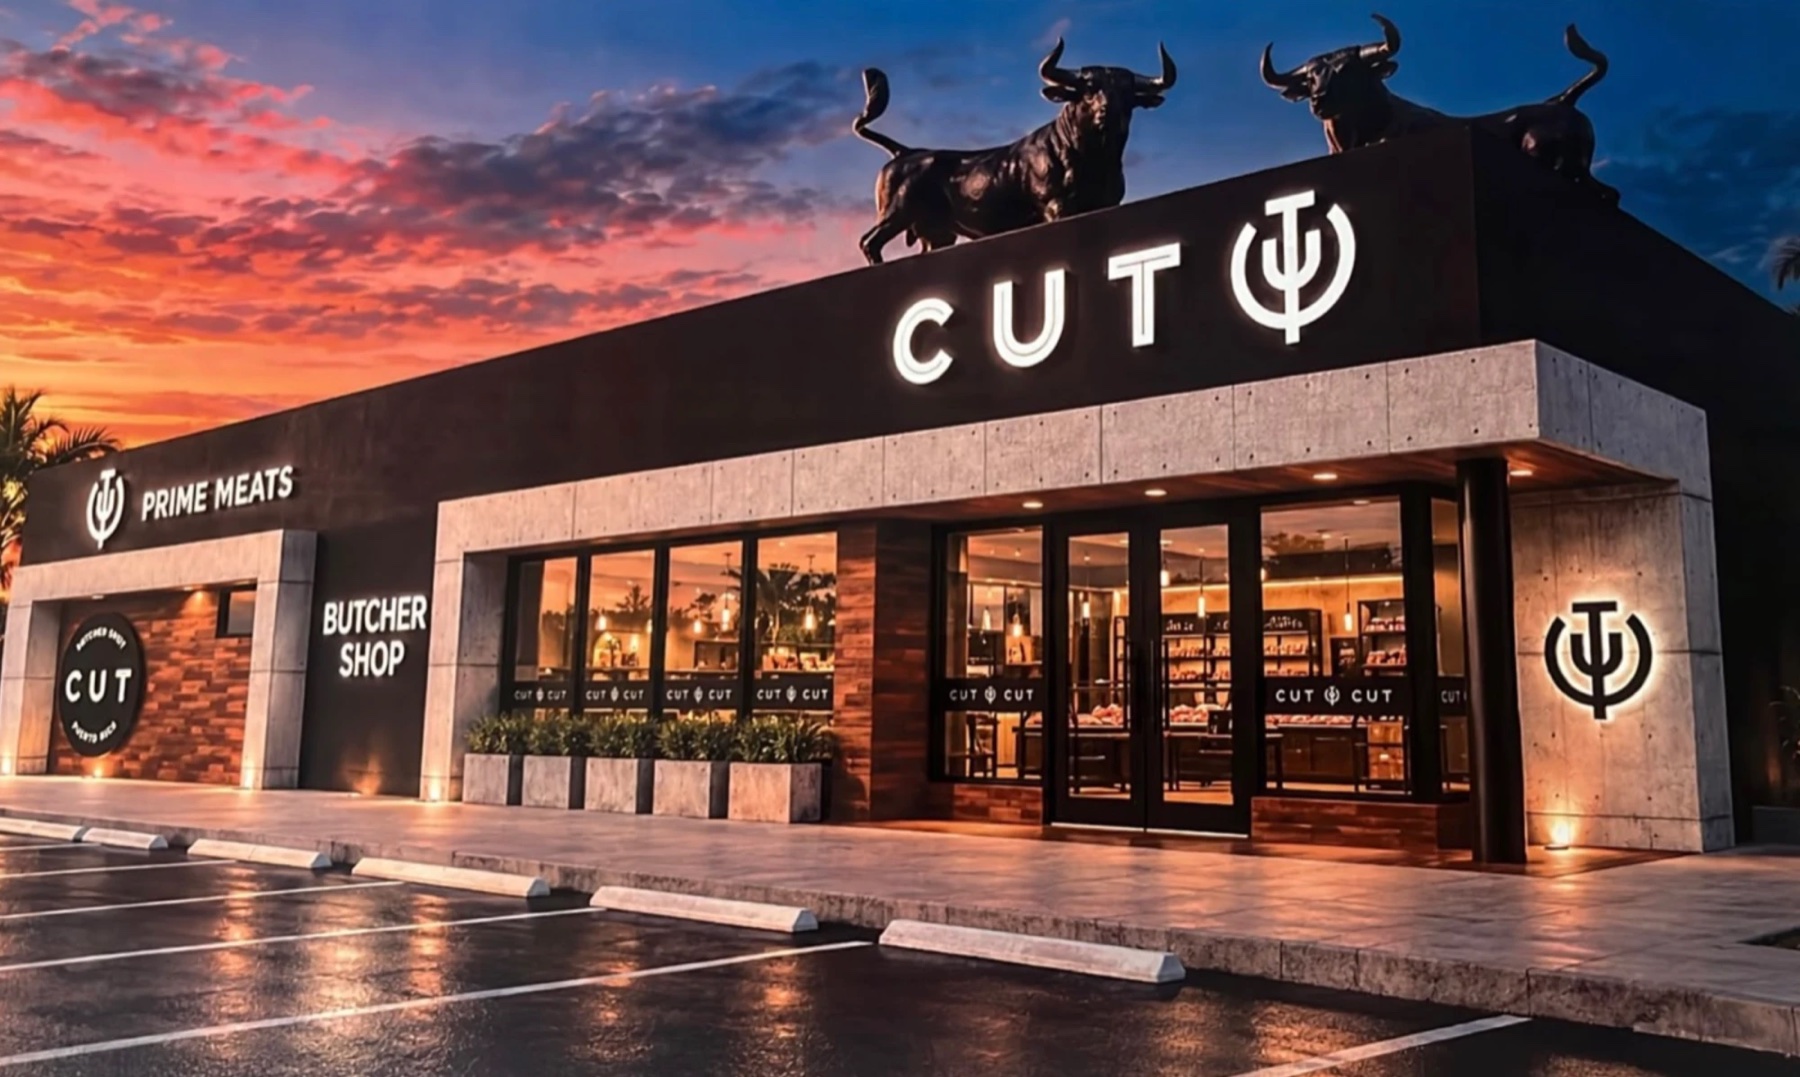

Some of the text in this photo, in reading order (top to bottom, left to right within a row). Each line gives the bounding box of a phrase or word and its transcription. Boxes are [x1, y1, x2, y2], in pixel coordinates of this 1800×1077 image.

[893, 242, 1181, 386] CUT
[141, 465, 293, 521] PRIME MEATS
[322, 595, 427, 635] BUTCHER
[339, 640, 405, 678] SHOP
[65, 668, 132, 703] CUT
[514, 690, 567, 700] CUT CUT
[586, 690, 644, 700] CUT CUT
[666, 689, 732, 700] CUT CUT
[756, 689, 829, 700] CUT CUT
[949, 689, 1034, 701] CUT CUT
[1275, 689, 1392, 702] CUT CUT
[1441, 690, 1460, 703] CUT
